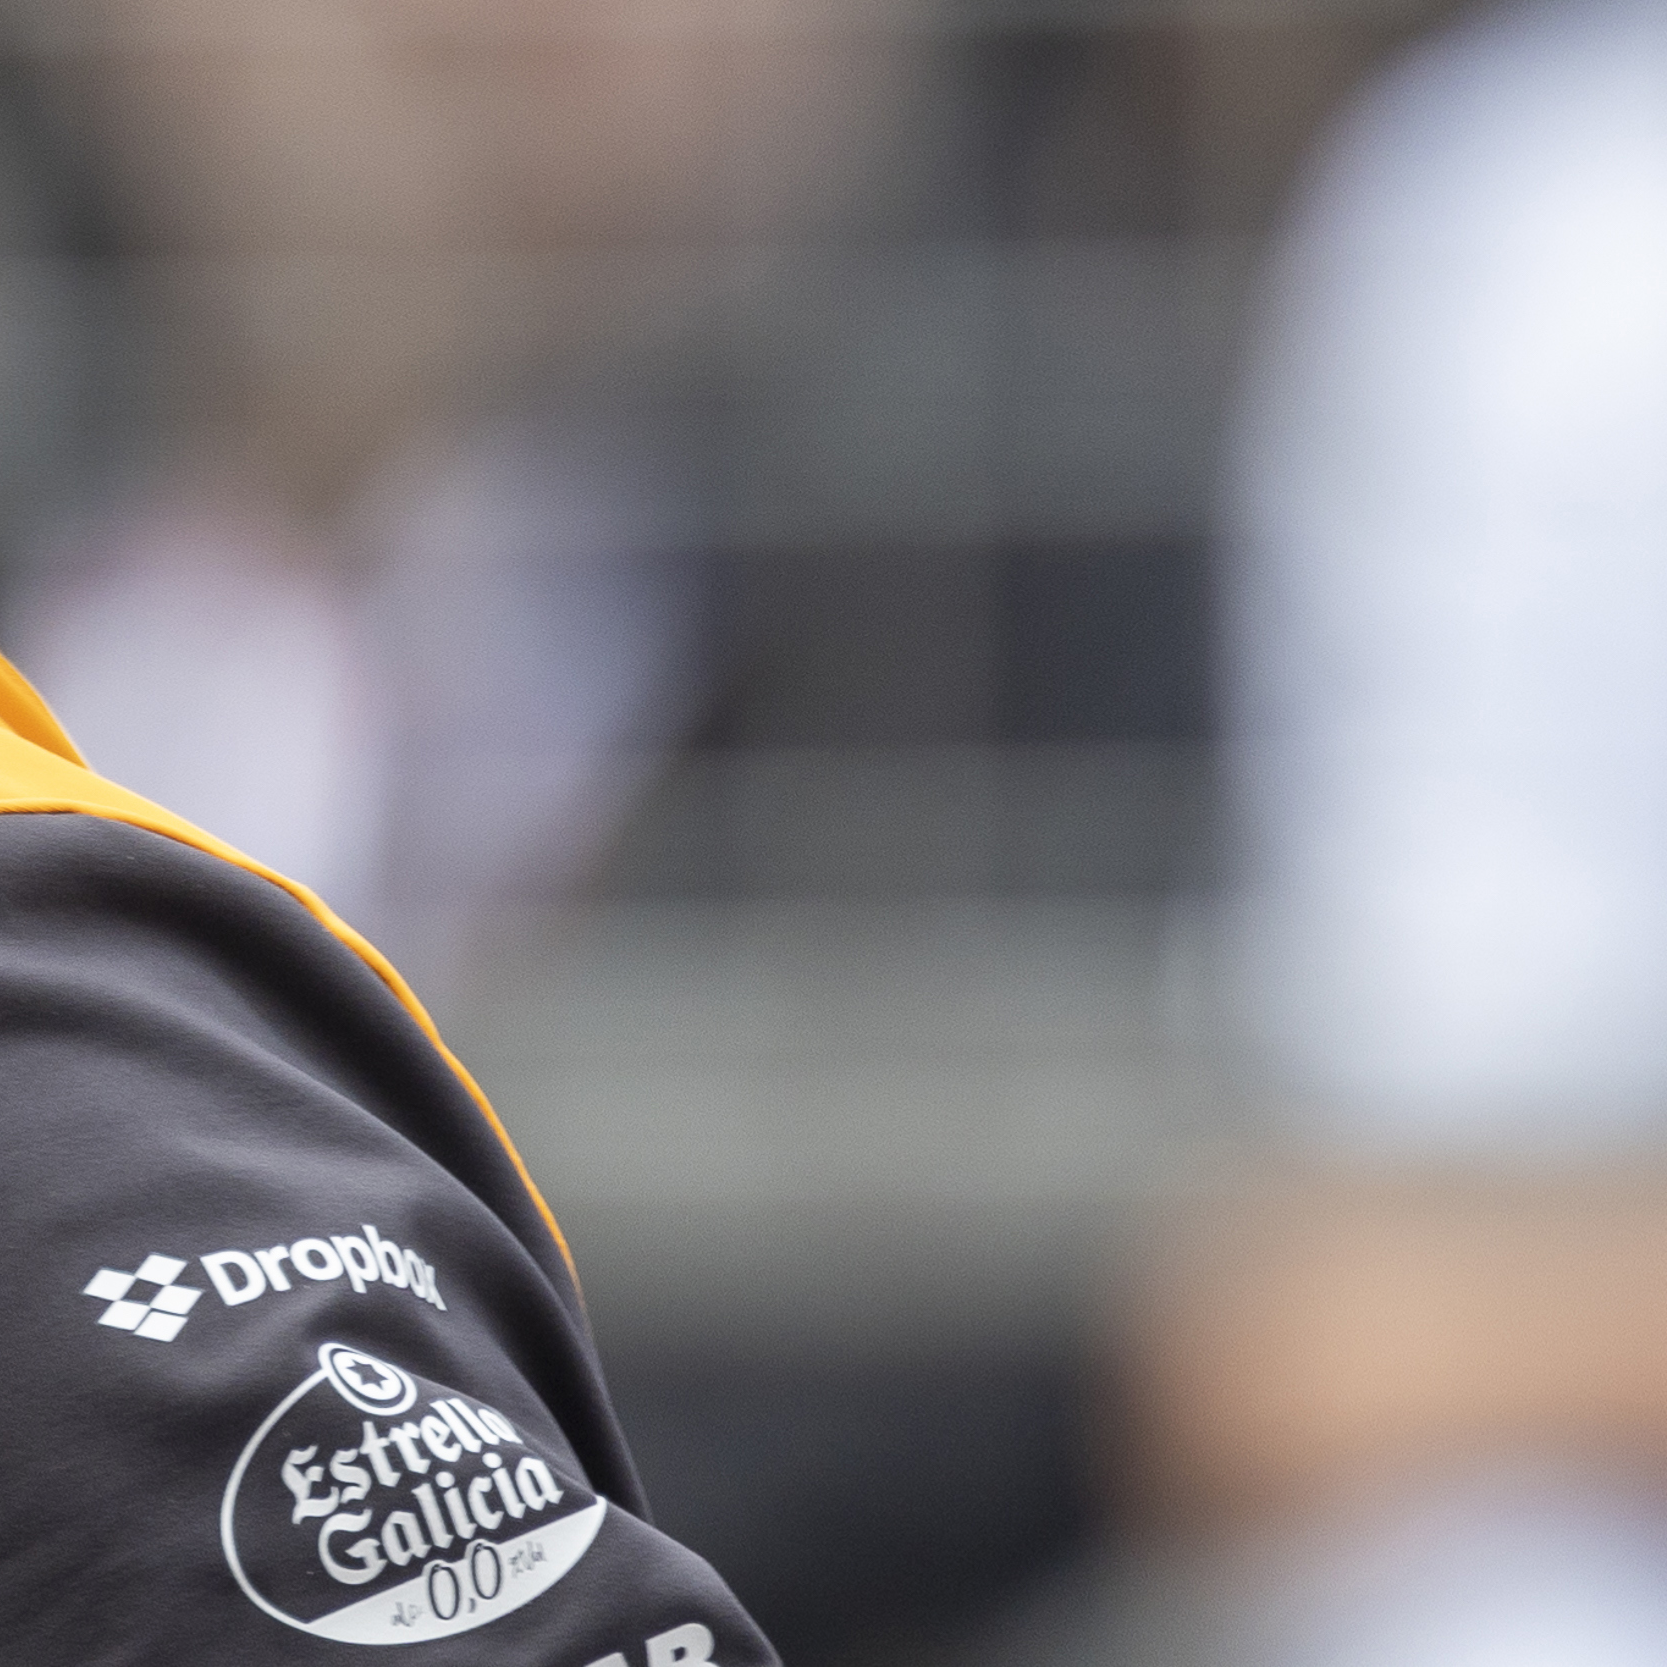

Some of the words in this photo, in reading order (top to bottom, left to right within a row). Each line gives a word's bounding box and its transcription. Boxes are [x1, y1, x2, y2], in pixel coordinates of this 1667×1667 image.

[201, 1225, 447, 1310] Dropbox
[281, 1398, 523, 1524] Estrella
[318, 1452, 564, 1585] Galicia
[428, 1542, 501, 1620] 0,0
